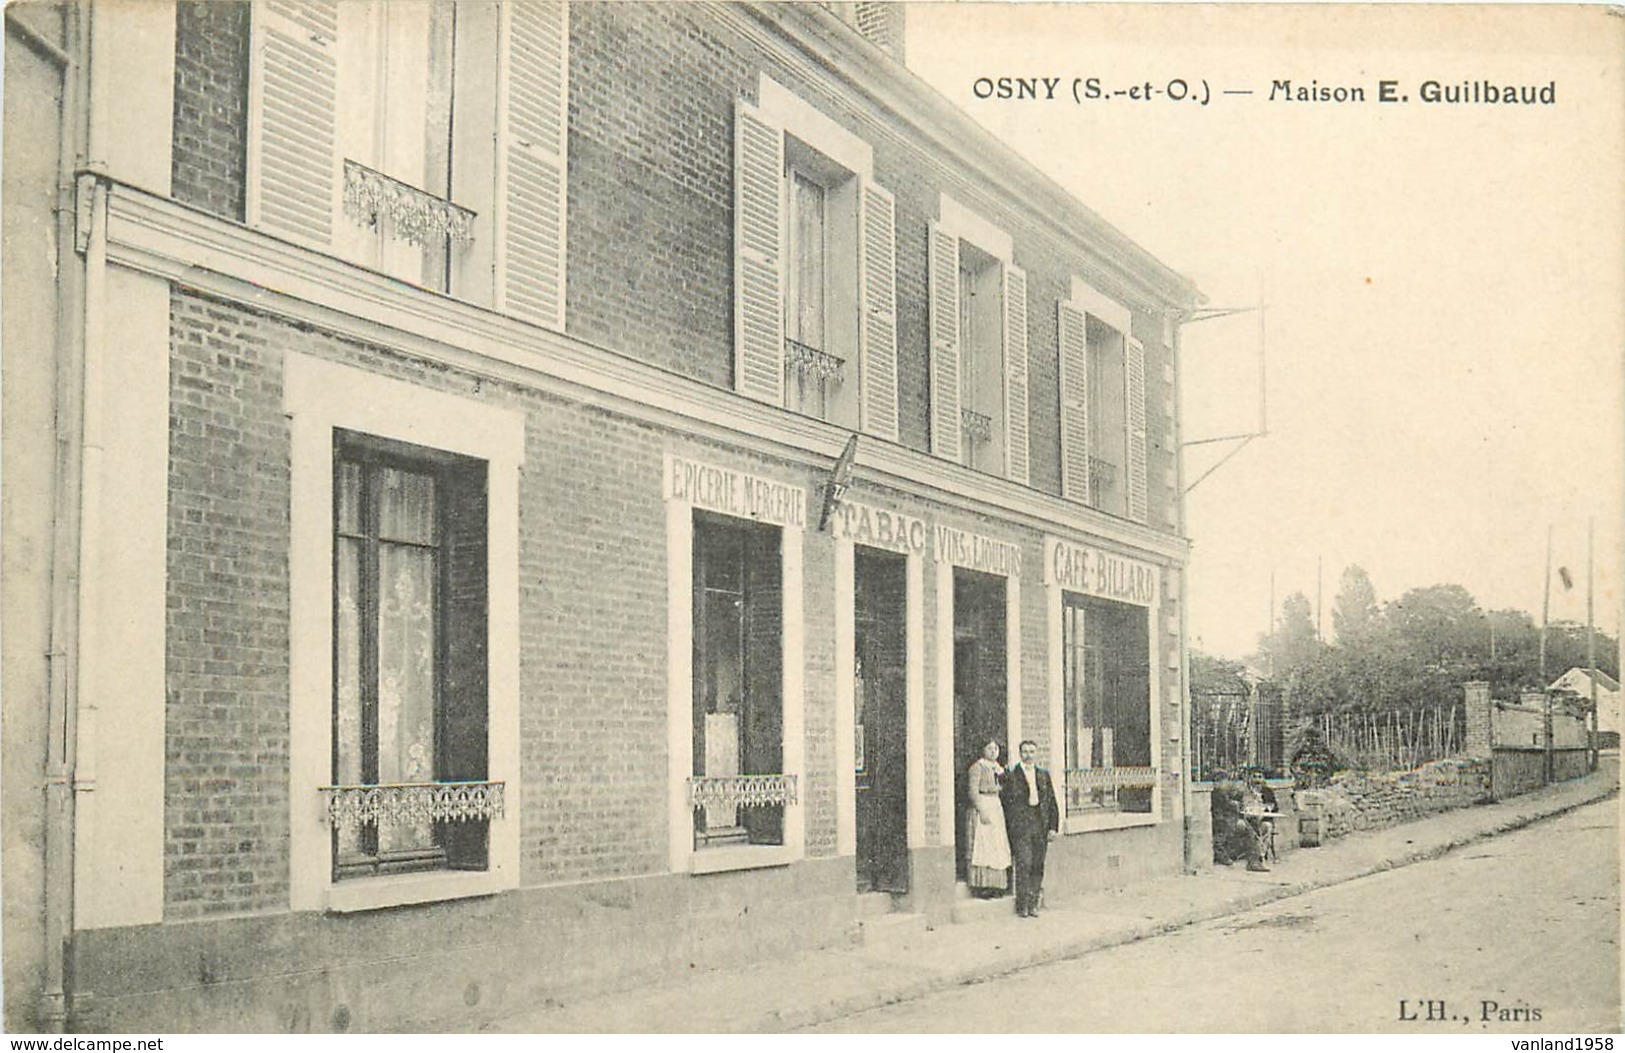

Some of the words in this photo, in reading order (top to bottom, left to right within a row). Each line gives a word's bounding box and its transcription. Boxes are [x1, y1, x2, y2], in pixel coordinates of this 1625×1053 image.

[672, 458, 738, 513] EPICERIE
[742, 474, 802, 527] MERCERIE
[837, 502, 925, 554] TABAC
